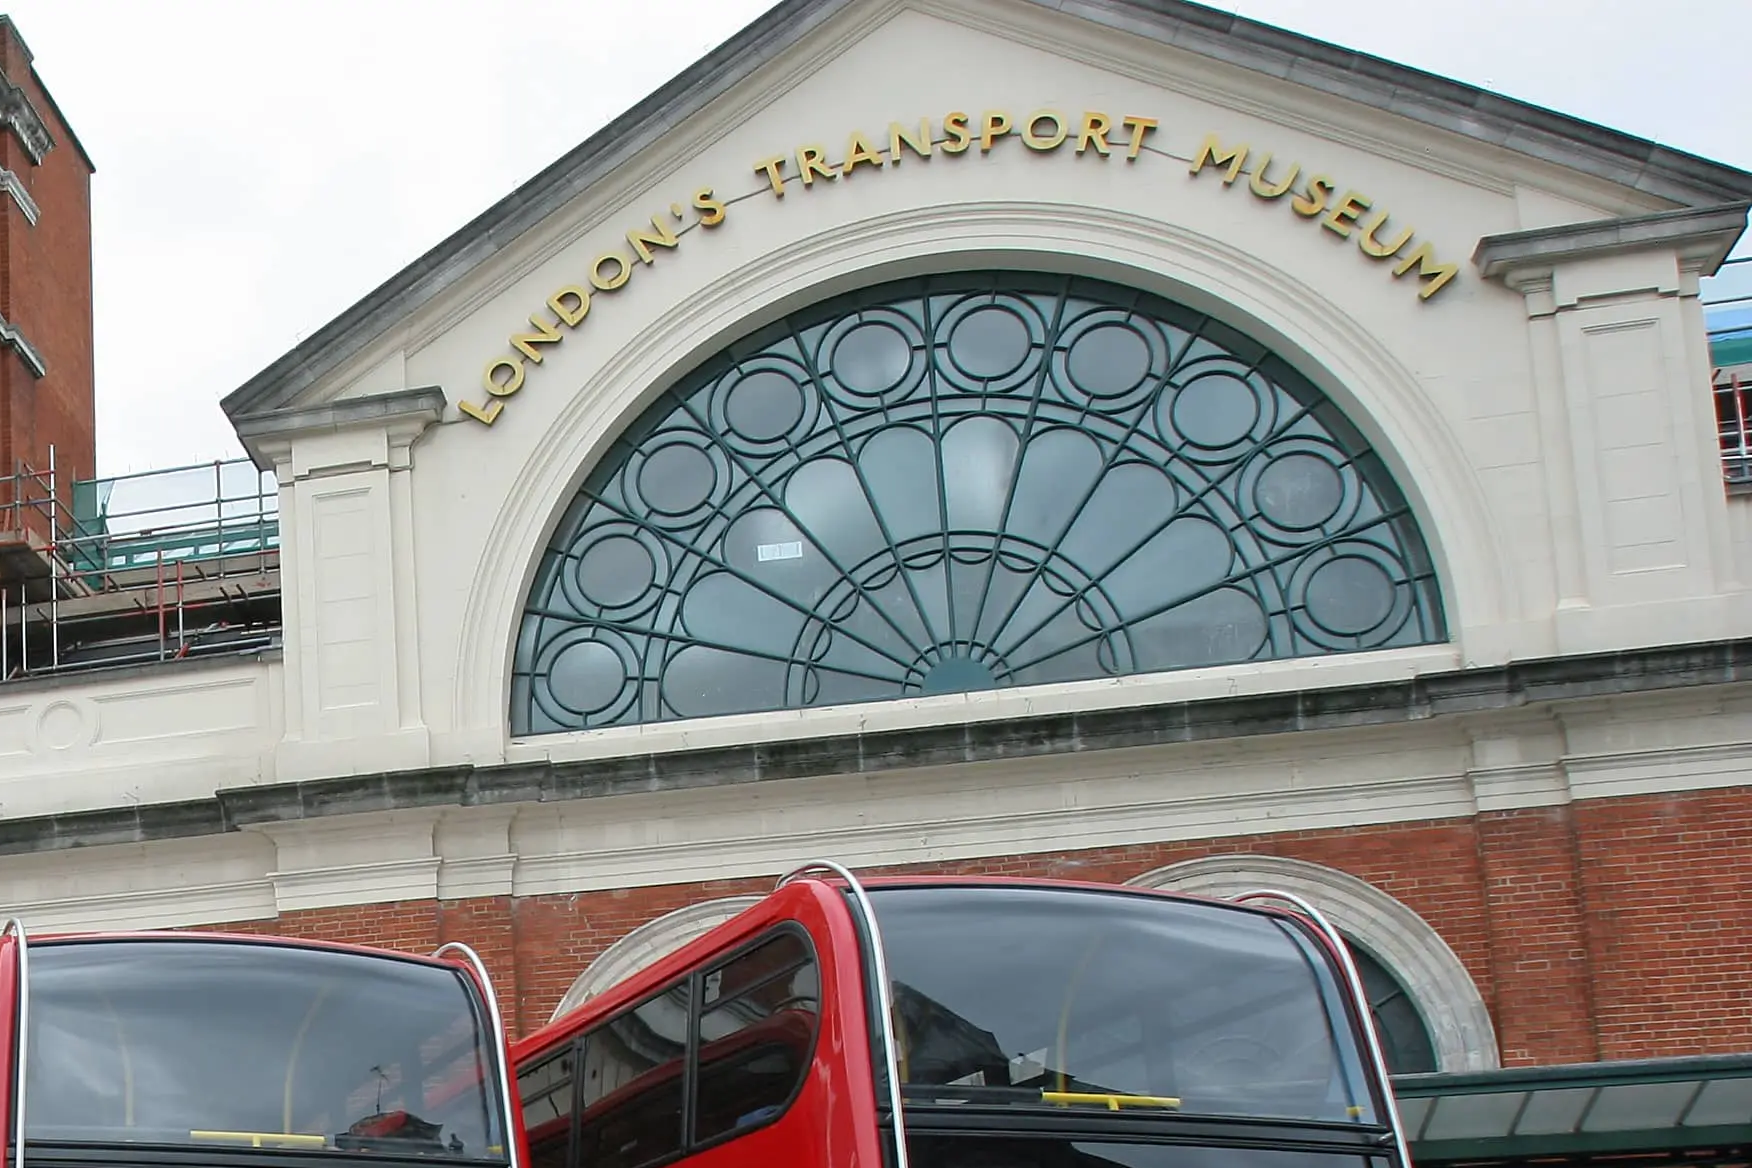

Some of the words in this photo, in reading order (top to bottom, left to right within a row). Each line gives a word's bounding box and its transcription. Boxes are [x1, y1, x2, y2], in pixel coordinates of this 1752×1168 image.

[457, 187, 728, 428] LONDON'S
[754, 109, 1159, 199] TRANSPORT
[1189, 132, 1461, 302] MUSEUM
